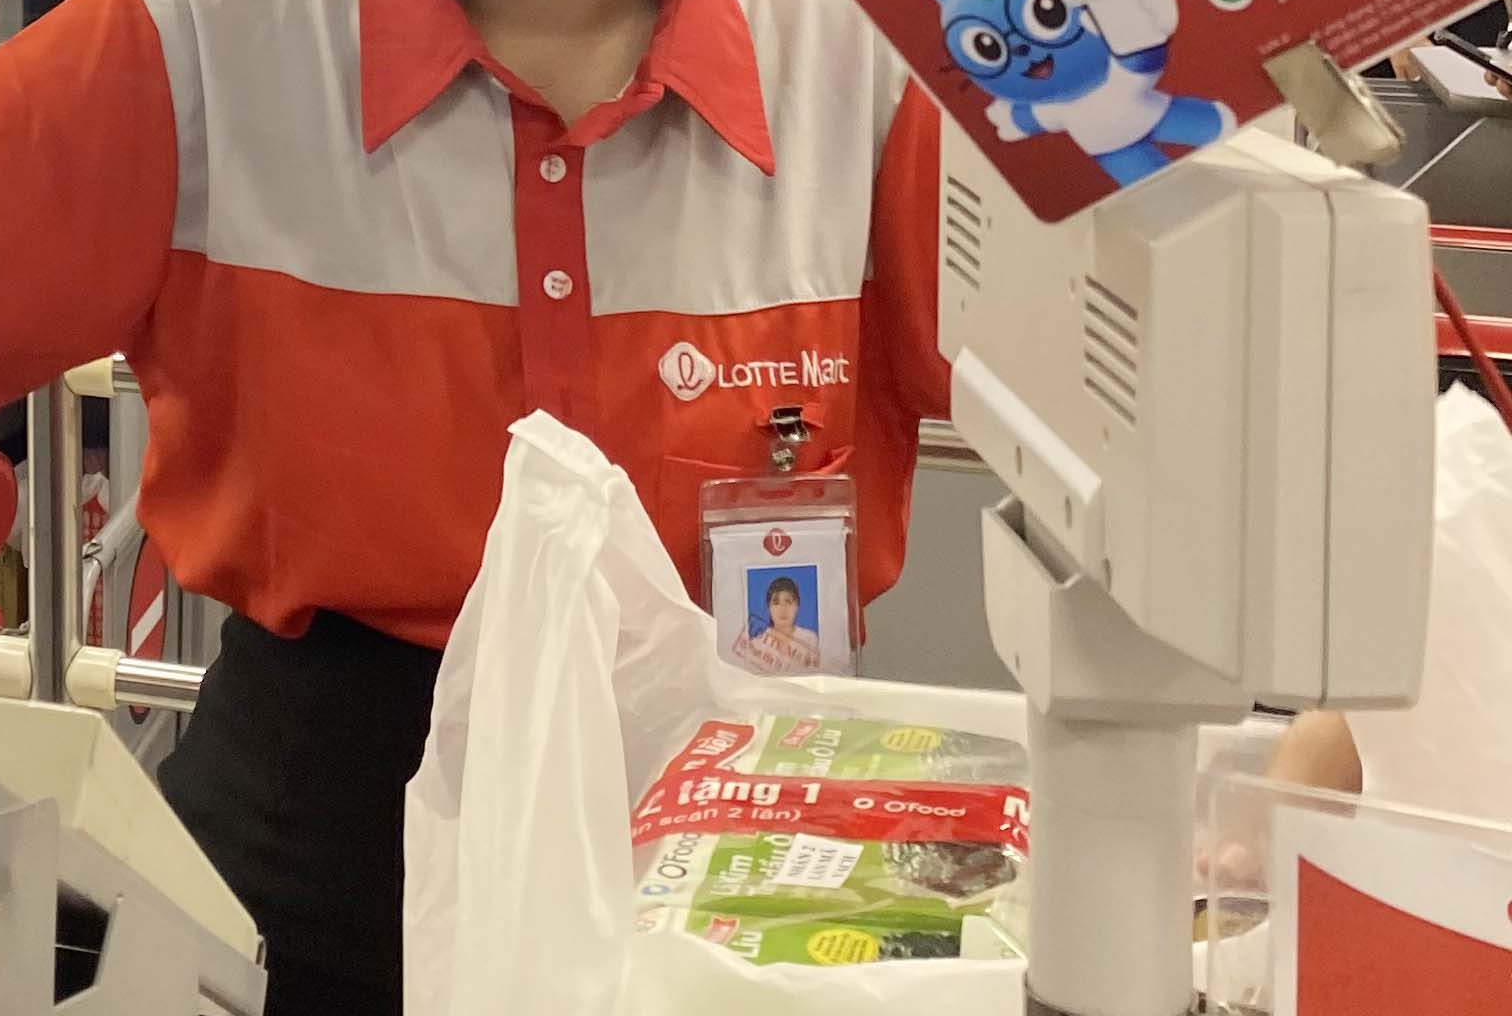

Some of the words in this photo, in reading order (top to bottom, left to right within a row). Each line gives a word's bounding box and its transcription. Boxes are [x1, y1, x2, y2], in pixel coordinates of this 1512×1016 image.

[717, 360, 800, 389] LOTTE
[800, 349, 851, 389] Mart
[677, 776, 782, 807] tặng
[801, 782, 822, 805] 1
[659, 807, 719, 827] scan
[727, 807, 744, 820] 2
